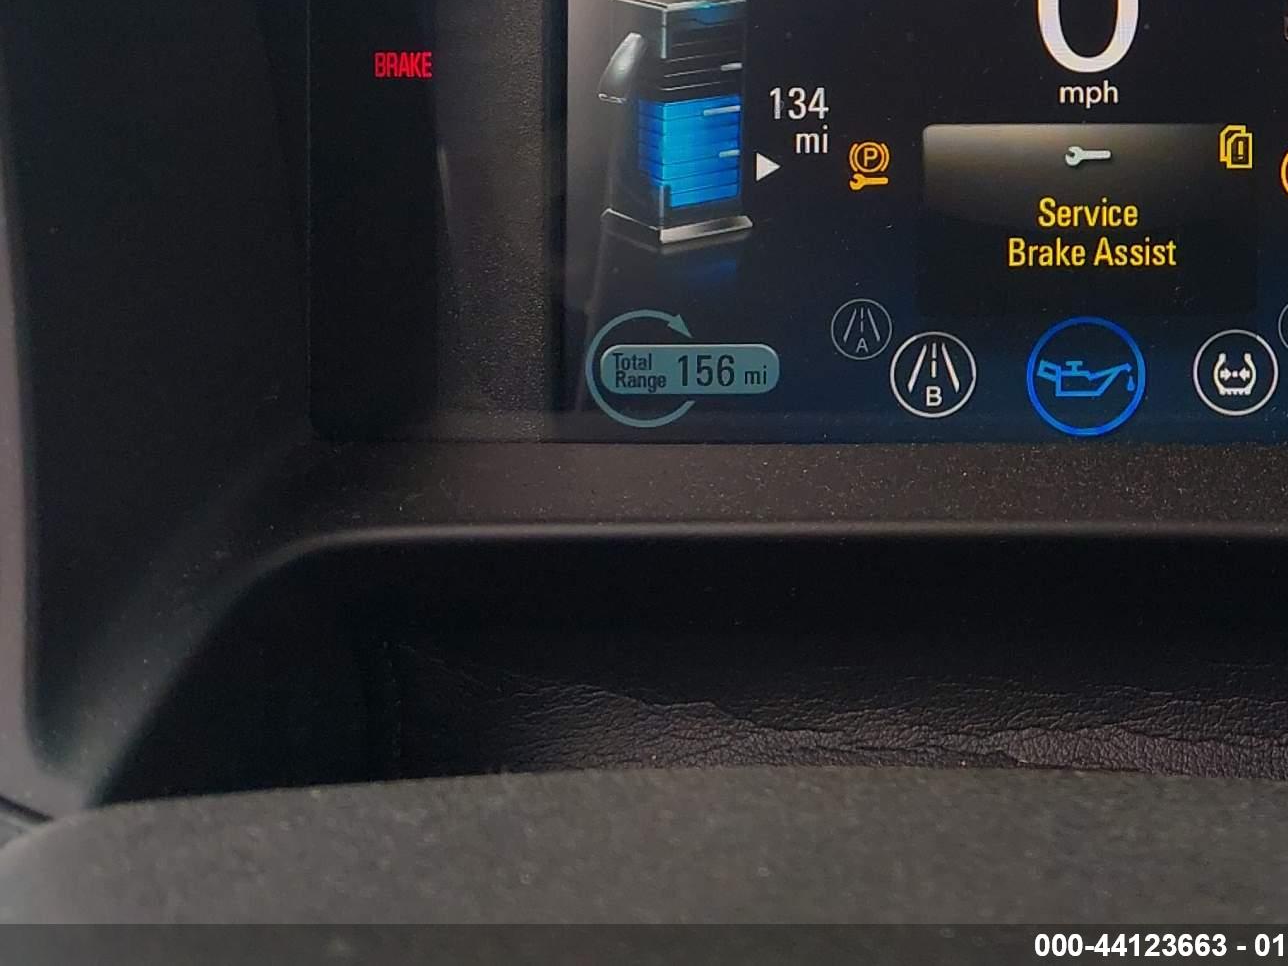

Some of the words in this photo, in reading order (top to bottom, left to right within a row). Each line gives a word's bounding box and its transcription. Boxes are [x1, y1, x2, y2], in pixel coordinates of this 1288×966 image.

[373, 51, 433, 79] BRAKE
[769, 86, 830, 120] 134
[1059, 82, 1119, 111] mph
[795, 126, 830, 155] mi
[1038, 198, 1139, 228] Service
[1008, 238, 1085, 268] Brake
[1094, 238, 1177, 267] Assist
[612, 352, 653, 371] Total
[677, 354, 735, 388] 156
[743, 363, 768, 386] mi
[614, 371, 667, 393] Range
[925, 386, 943, 408] B
